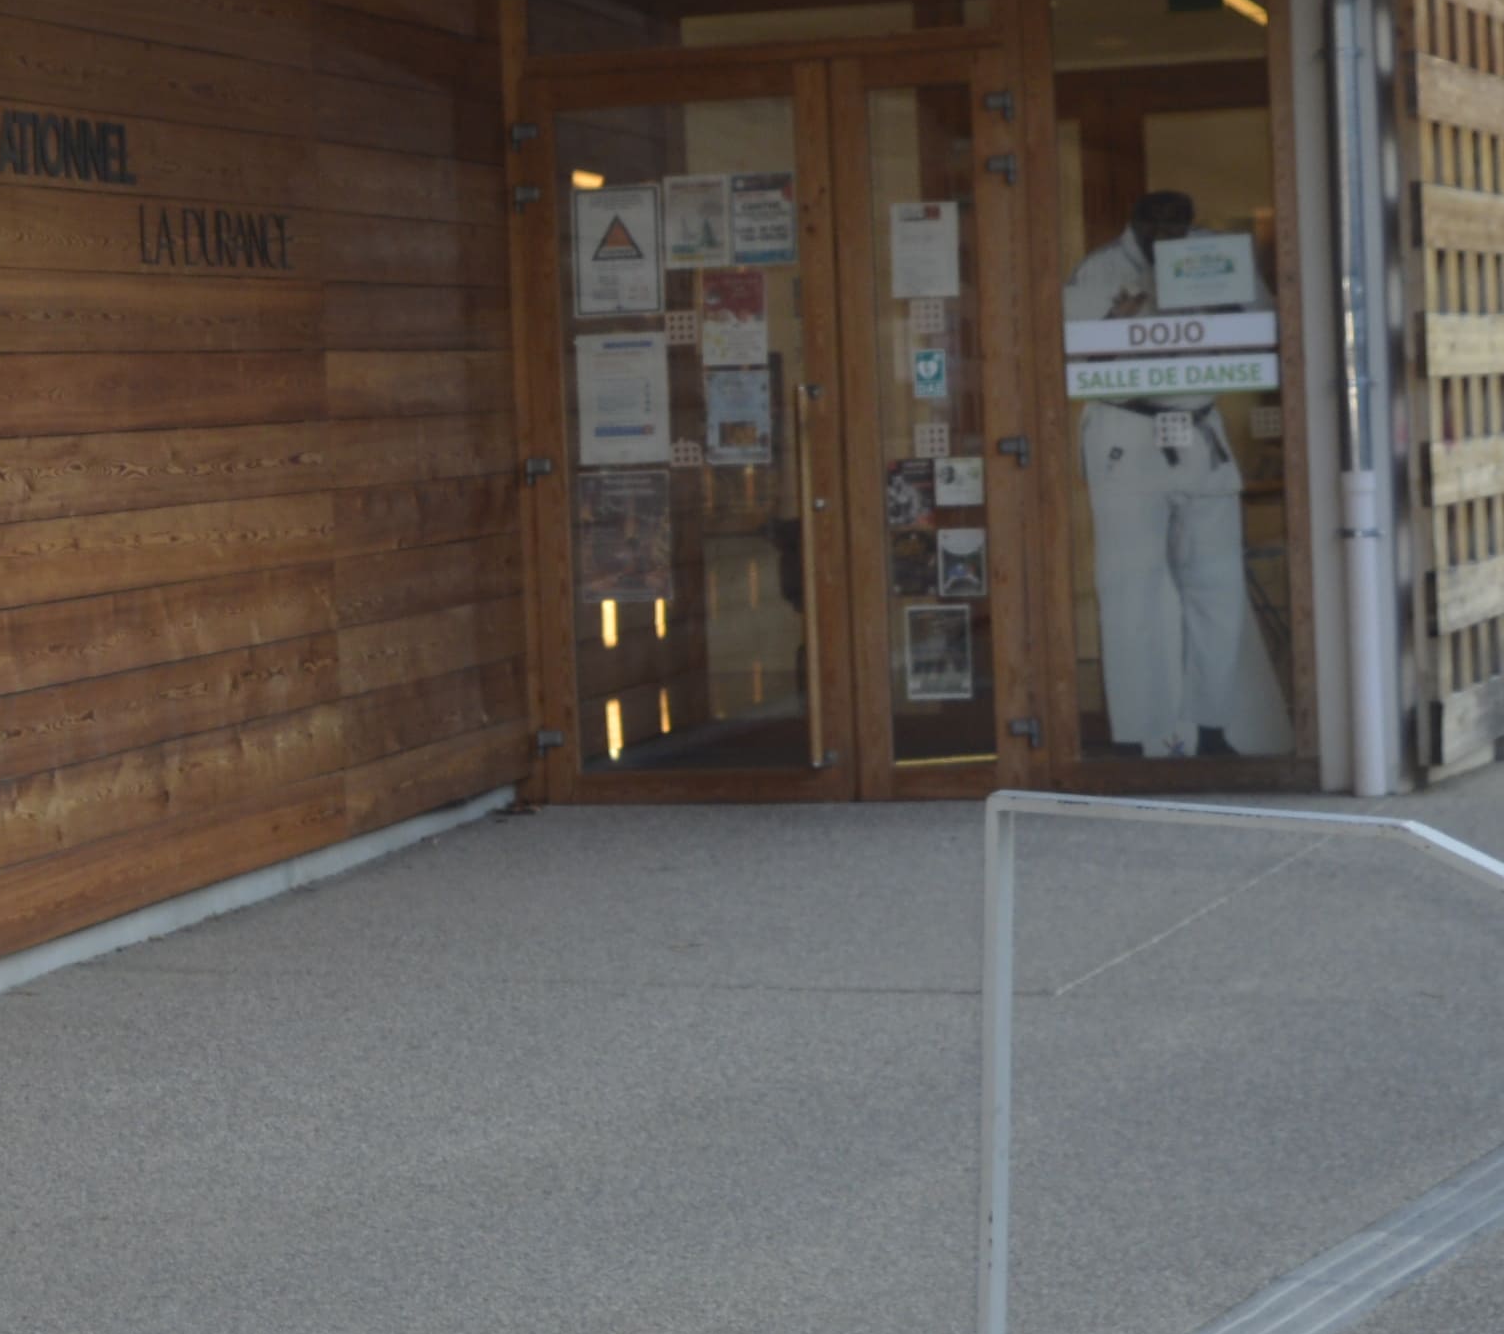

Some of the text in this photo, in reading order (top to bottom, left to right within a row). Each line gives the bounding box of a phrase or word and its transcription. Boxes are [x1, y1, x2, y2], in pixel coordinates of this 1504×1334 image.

[139, 203, 175, 266] LA
[1128, 321, 1204, 346] DOJO
[1077, 362, 1261, 389] SALLE DE DANSE
